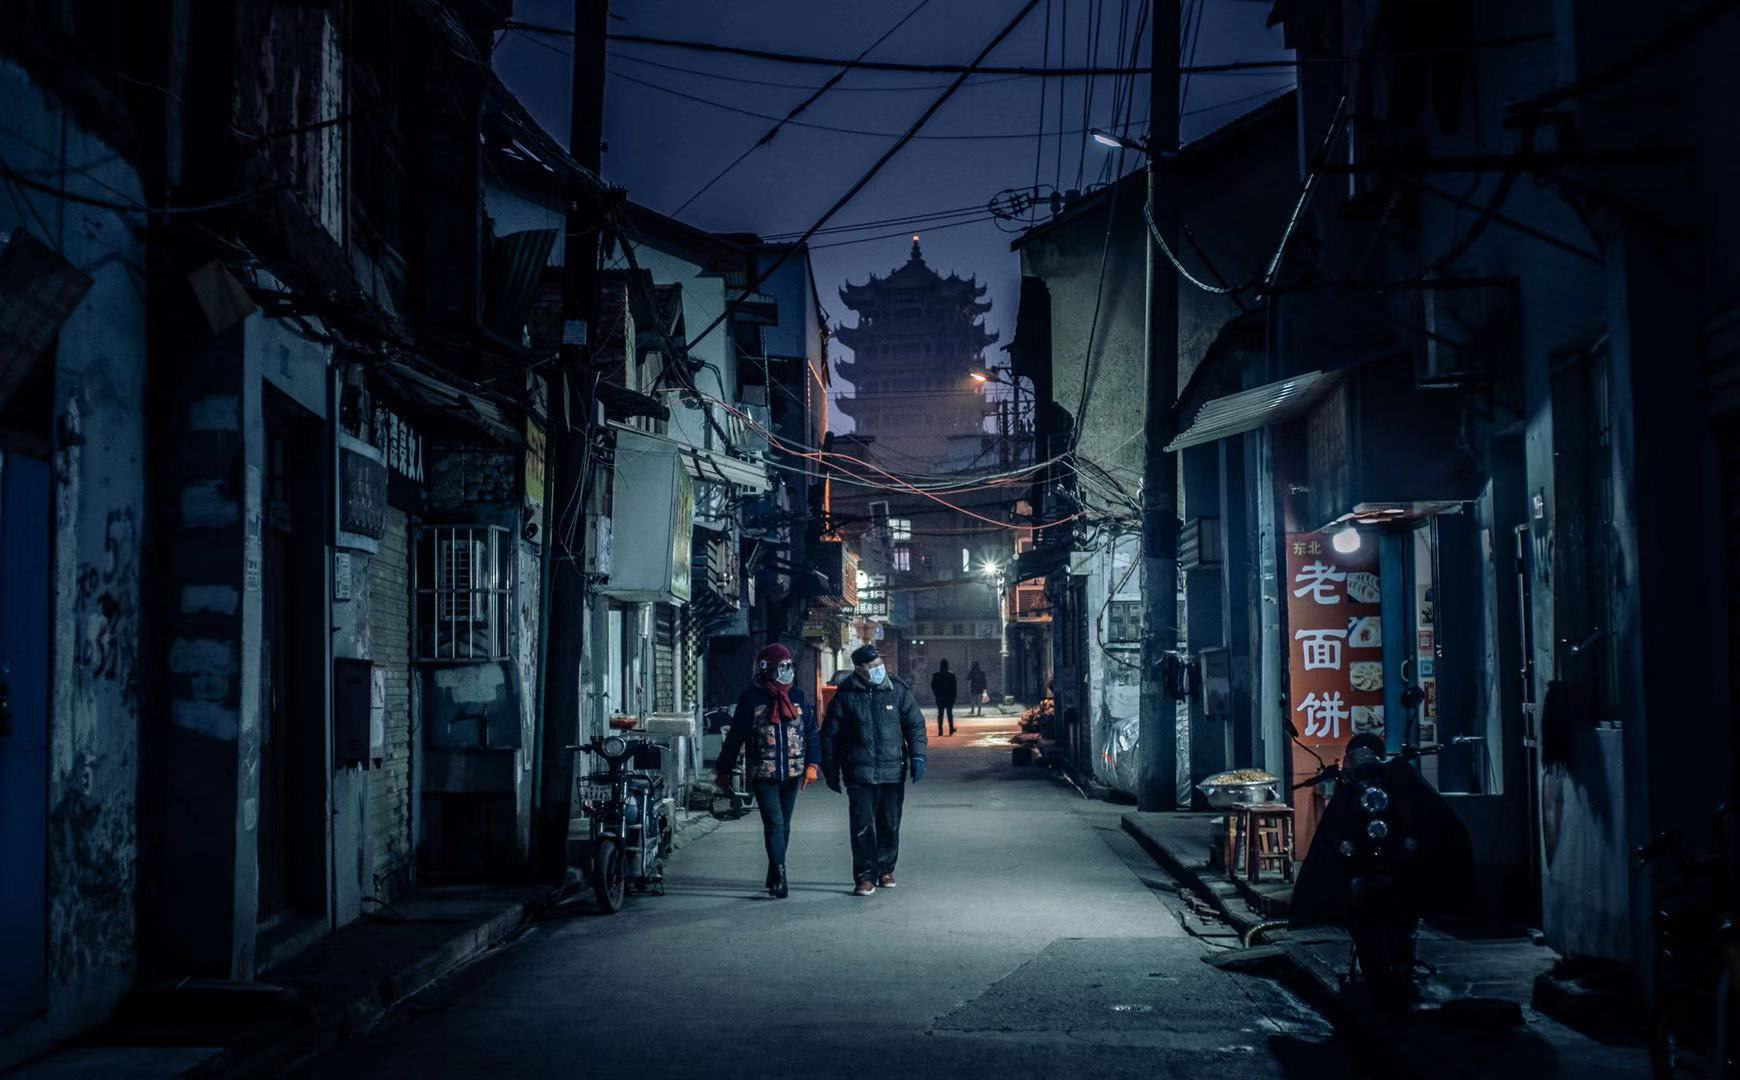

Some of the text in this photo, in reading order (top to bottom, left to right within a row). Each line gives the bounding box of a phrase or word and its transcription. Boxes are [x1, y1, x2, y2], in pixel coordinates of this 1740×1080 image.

[1293, 541, 1322, 555] 东北
[1293, 560, 1350, 739] 老面饼
